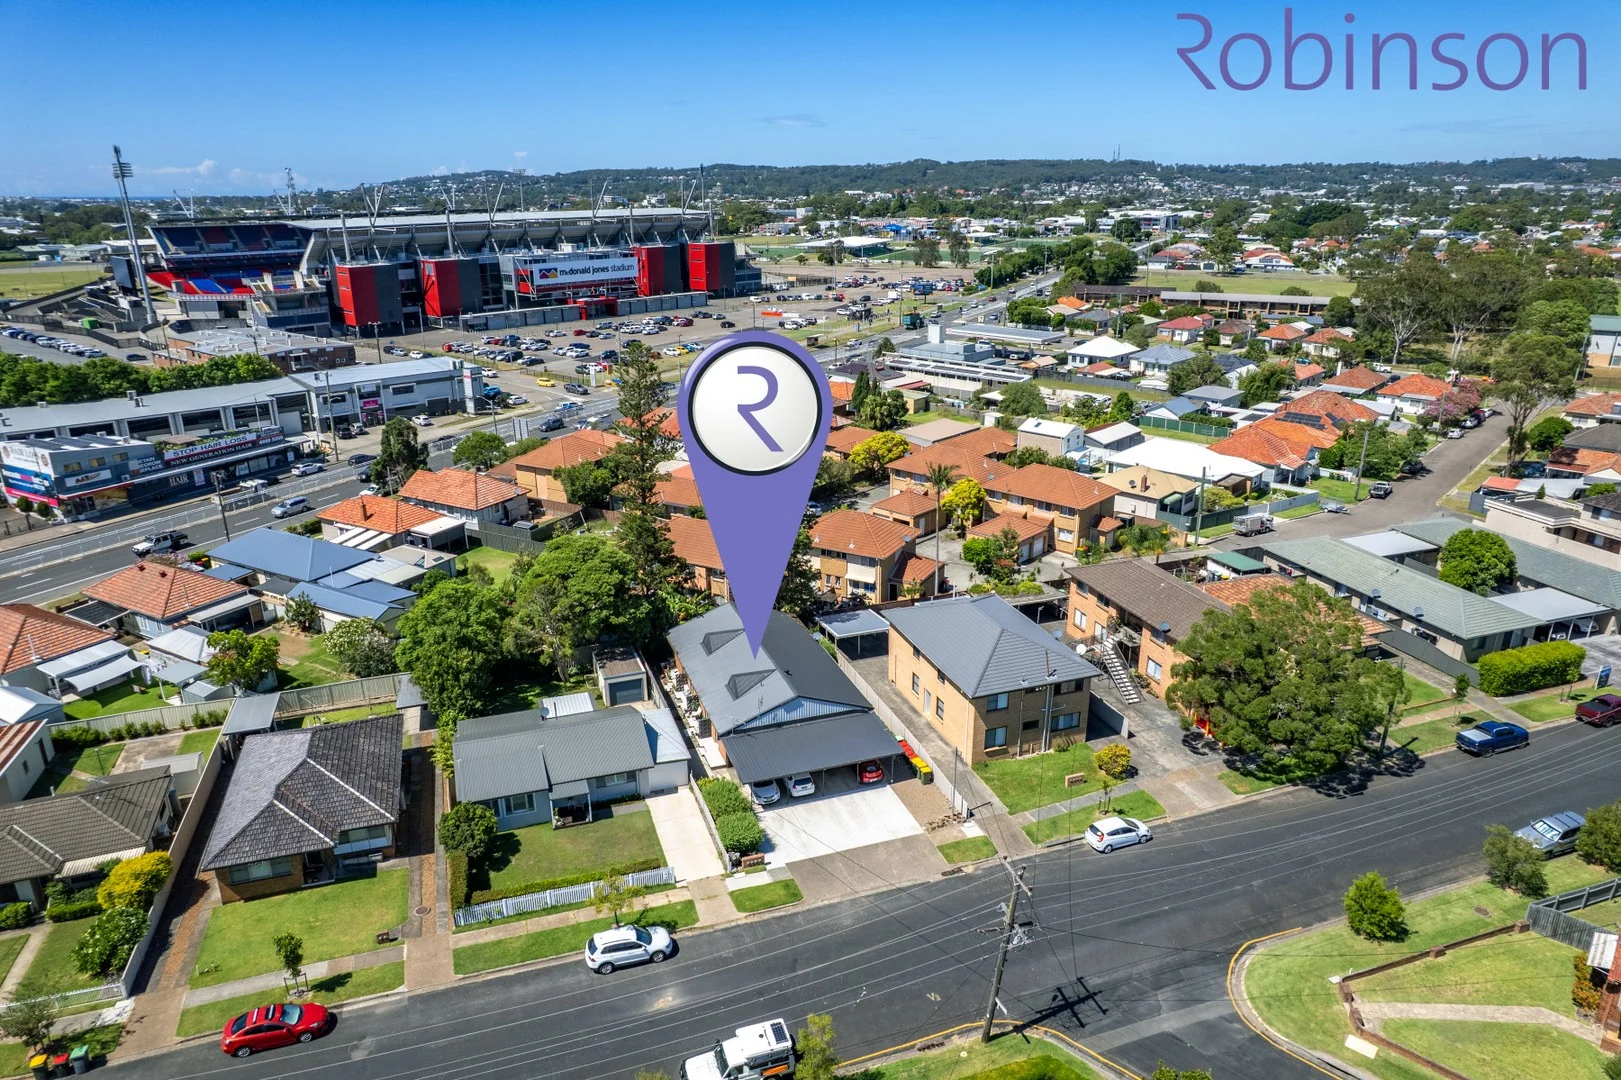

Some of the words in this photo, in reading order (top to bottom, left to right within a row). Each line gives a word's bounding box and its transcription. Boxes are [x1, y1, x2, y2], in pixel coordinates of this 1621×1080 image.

[591, 265, 609, 275] jones
[610, 263, 635, 272] stadium
[170, 457, 189, 466] NEW
[188, 446, 235, 463] GENERATION
[235, 443, 253, 452] HAIR
[173, 446, 198, 457] STOP
[200, 441, 222, 452] HAIR
[224, 435, 248, 446] LOSS
[169, 473, 190, 487] HAIR
